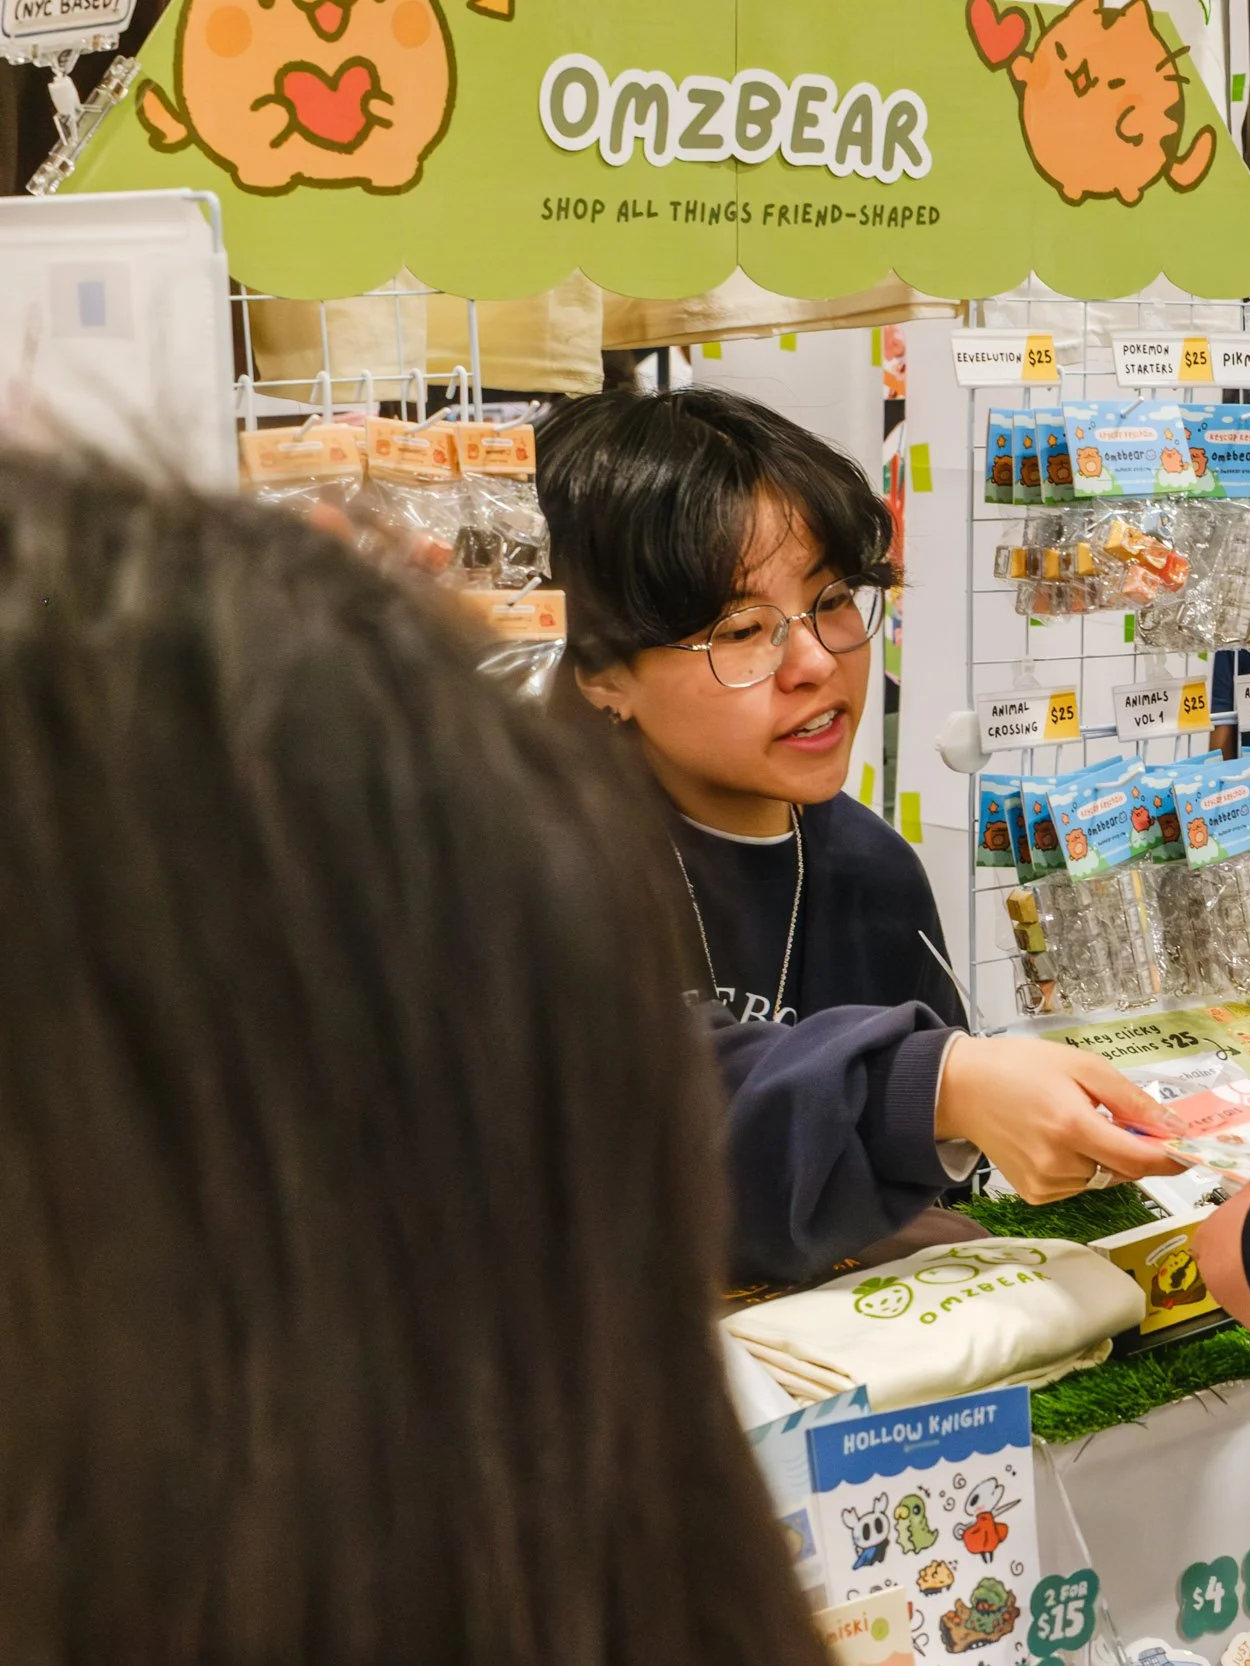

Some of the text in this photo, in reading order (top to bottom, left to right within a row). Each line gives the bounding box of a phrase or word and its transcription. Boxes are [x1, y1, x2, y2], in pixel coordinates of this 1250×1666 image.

[548, 65, 924, 173] OMZBEAR
[541, 197, 941, 228] SHOP ALL THINGS FRIEND-SHAPED
[957, 351, 1022, 365] EEVEELUTION
[1028, 350, 1052, 369] $25
[1122, 343, 1170, 357] POKEMON
[1184, 350, 1208, 368] $25
[1125, 362, 1174, 375] STARTERS
[991, 701, 1030, 717] ANIMAL
[1125, 690, 1169, 709] ANIMALS
[1183, 695, 1206, 714] $25
[1050, 704, 1075, 724] $25
[1134, 712, 1155, 727] VOL
[987, 720, 1038, 738] CROSSING
[1065, 1023, 1161, 1048] 4-key clicky
[1101, 1031, 1200, 1061] ychains $25
[919, 1270, 1052, 1325] OMZBEAR
[842, 1404, 998, 1456] HOLLOW KNIGHT
[1043, 1580, 1089, 1608] 2 FOR
[1192, 1575, 1226, 1614] $4
[1037, 1599, 1086, 1642] $15
